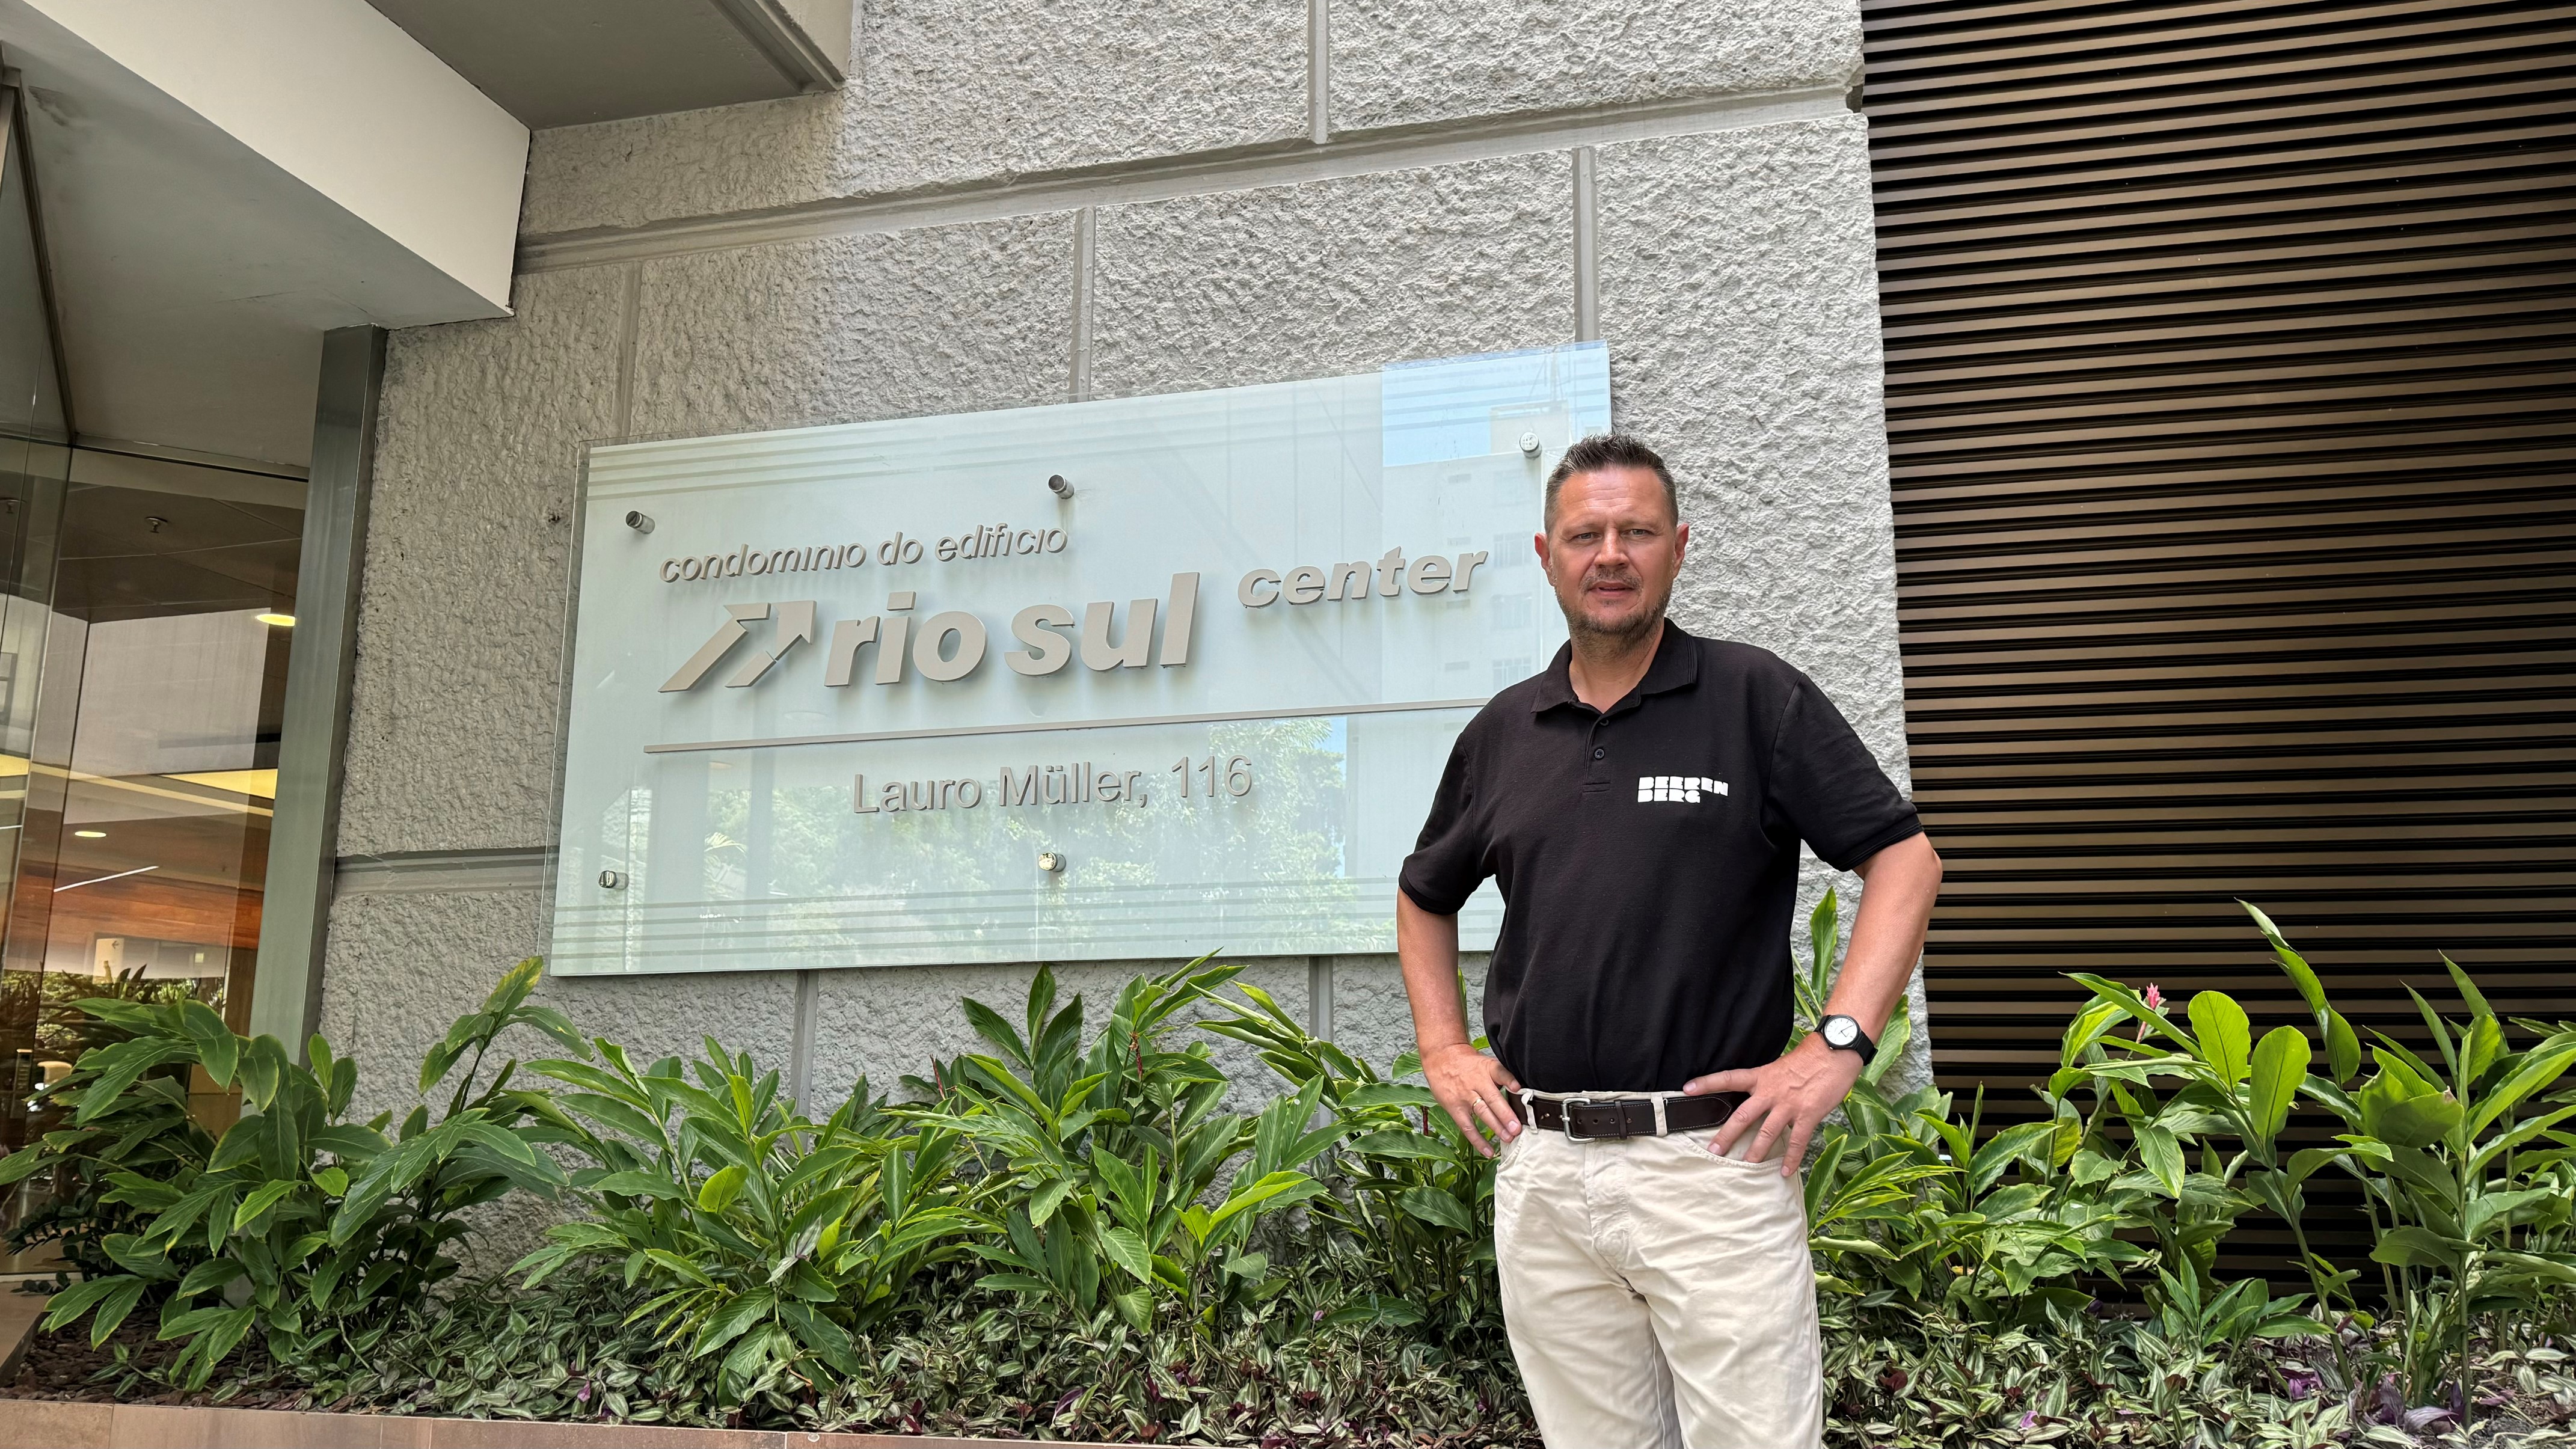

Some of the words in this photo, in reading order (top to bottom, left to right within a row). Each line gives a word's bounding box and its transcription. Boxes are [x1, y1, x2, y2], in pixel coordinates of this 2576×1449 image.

[877, 532, 924, 566] do
[824, 591, 988, 688] rio
[1004, 572, 1200, 676] sul
[1237, 546, 1488, 608] center
[853, 774, 982, 813] Lauro
[998, 761, 1148, 808] Müller,
[1171, 755, 1253, 798] 116
[1637, 789, 1700, 803] BERG
[1639, 776, 1728, 796] BEEREN
